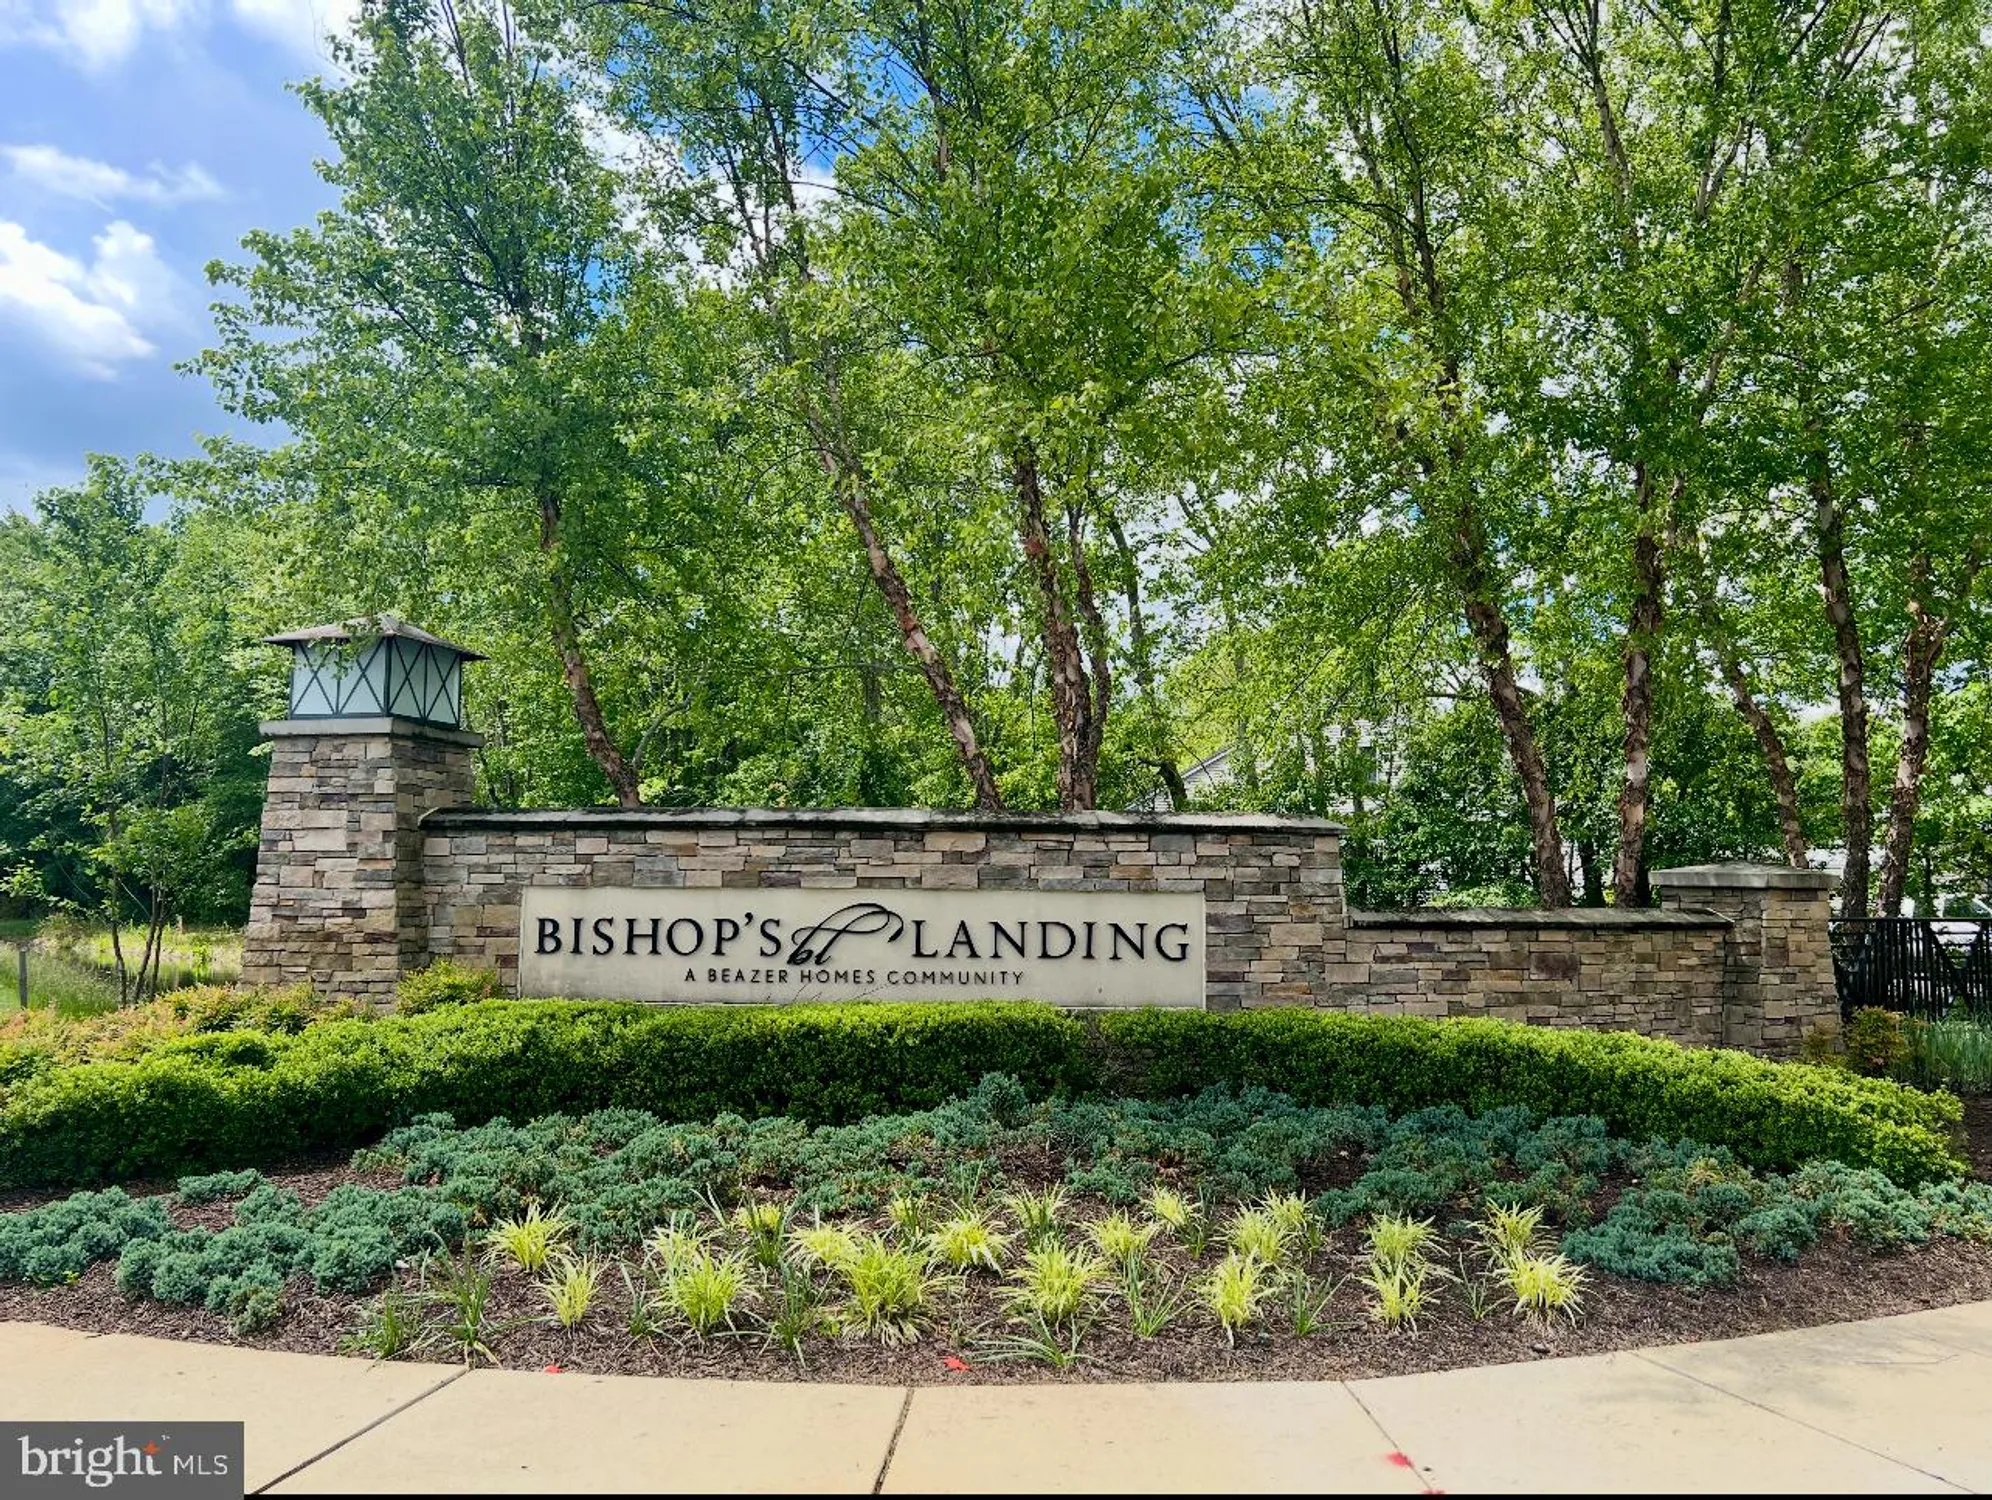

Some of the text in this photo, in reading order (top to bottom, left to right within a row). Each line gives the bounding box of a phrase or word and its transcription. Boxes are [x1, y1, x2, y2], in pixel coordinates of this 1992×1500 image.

[534, 912, 1190, 962] BISHOP'S LANDING
[684, 968, 1024, 986] A BEAZER HOMES COMMUNITY
